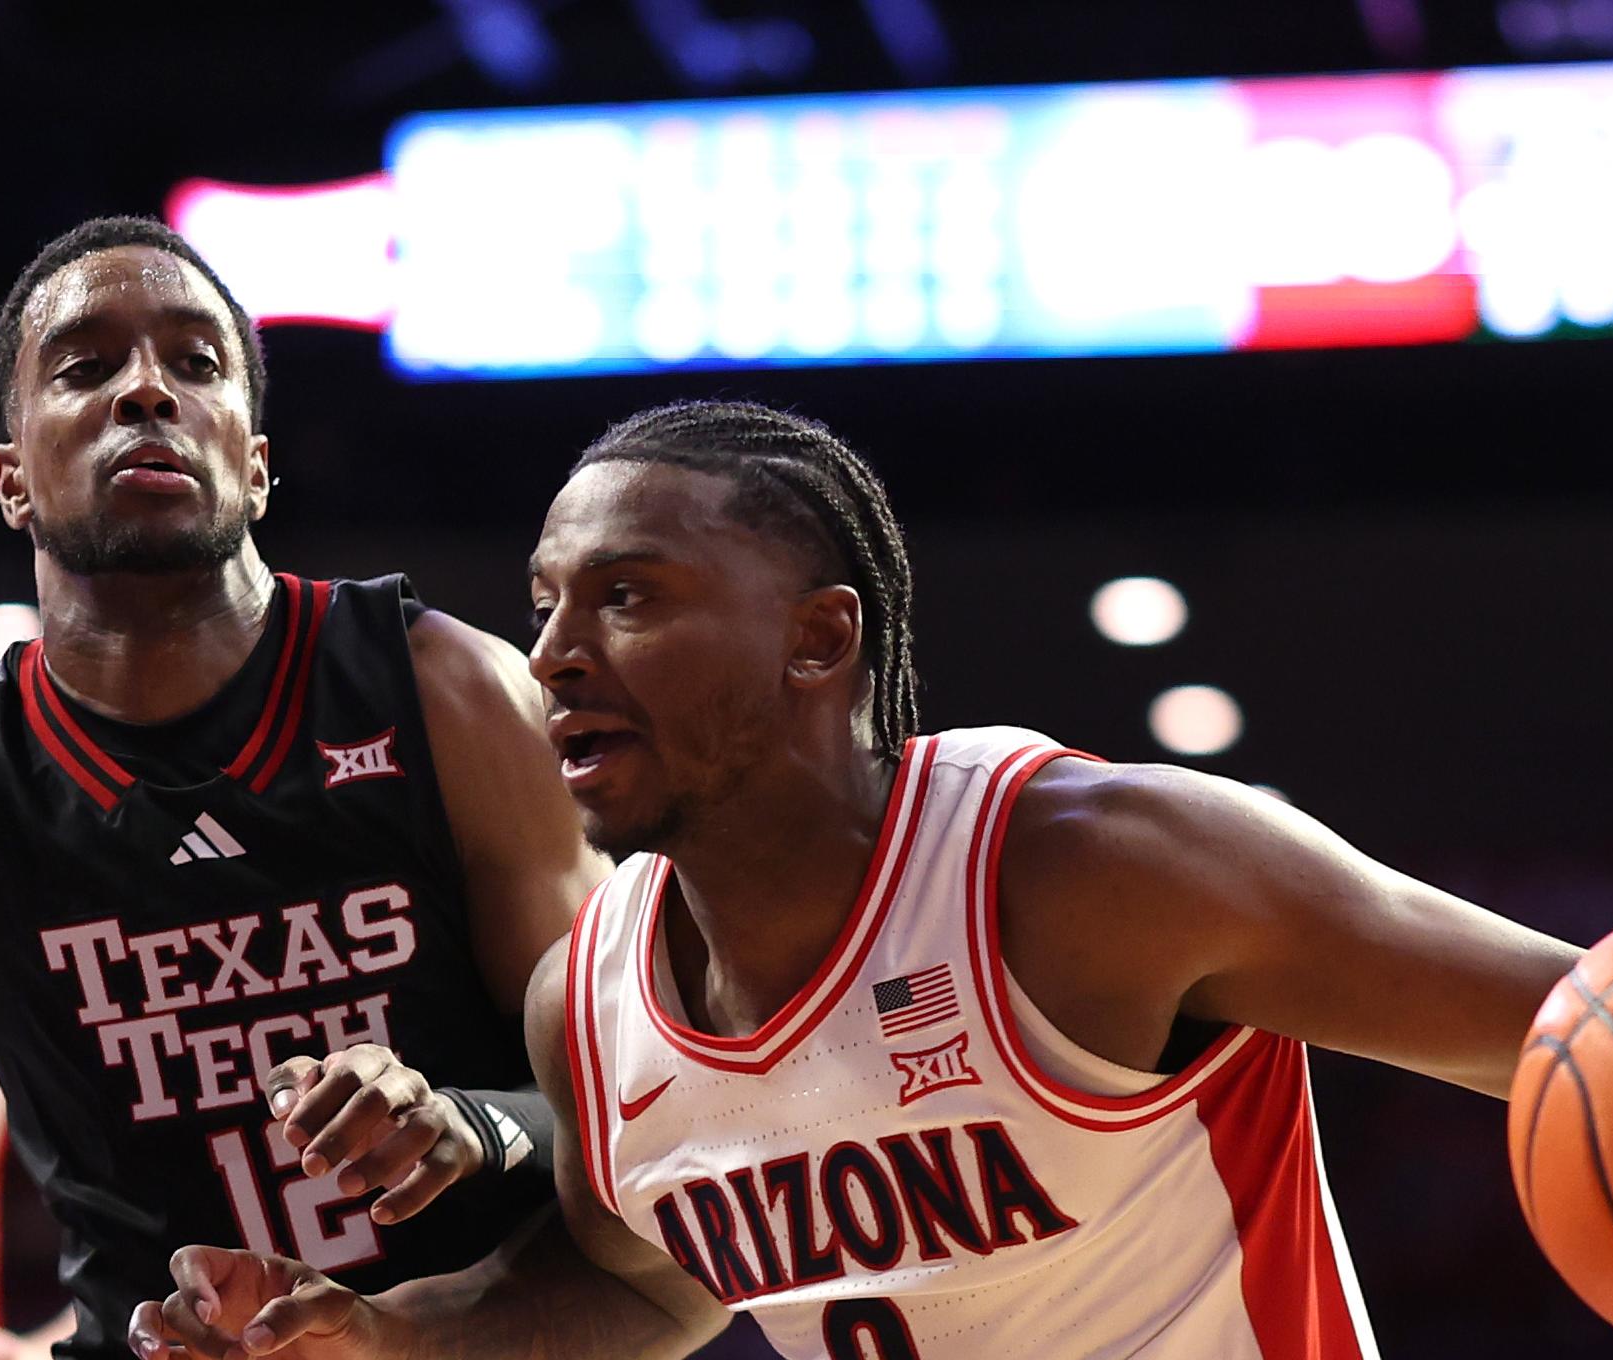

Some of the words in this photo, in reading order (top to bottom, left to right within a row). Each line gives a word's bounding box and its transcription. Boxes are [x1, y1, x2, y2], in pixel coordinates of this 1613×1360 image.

[322, 733, 400, 786] XII
[41, 884, 417, 1025] TEXAS
[895, 1039, 975, 1099] XII
[654, 1121, 1080, 1306] ARIZONA
